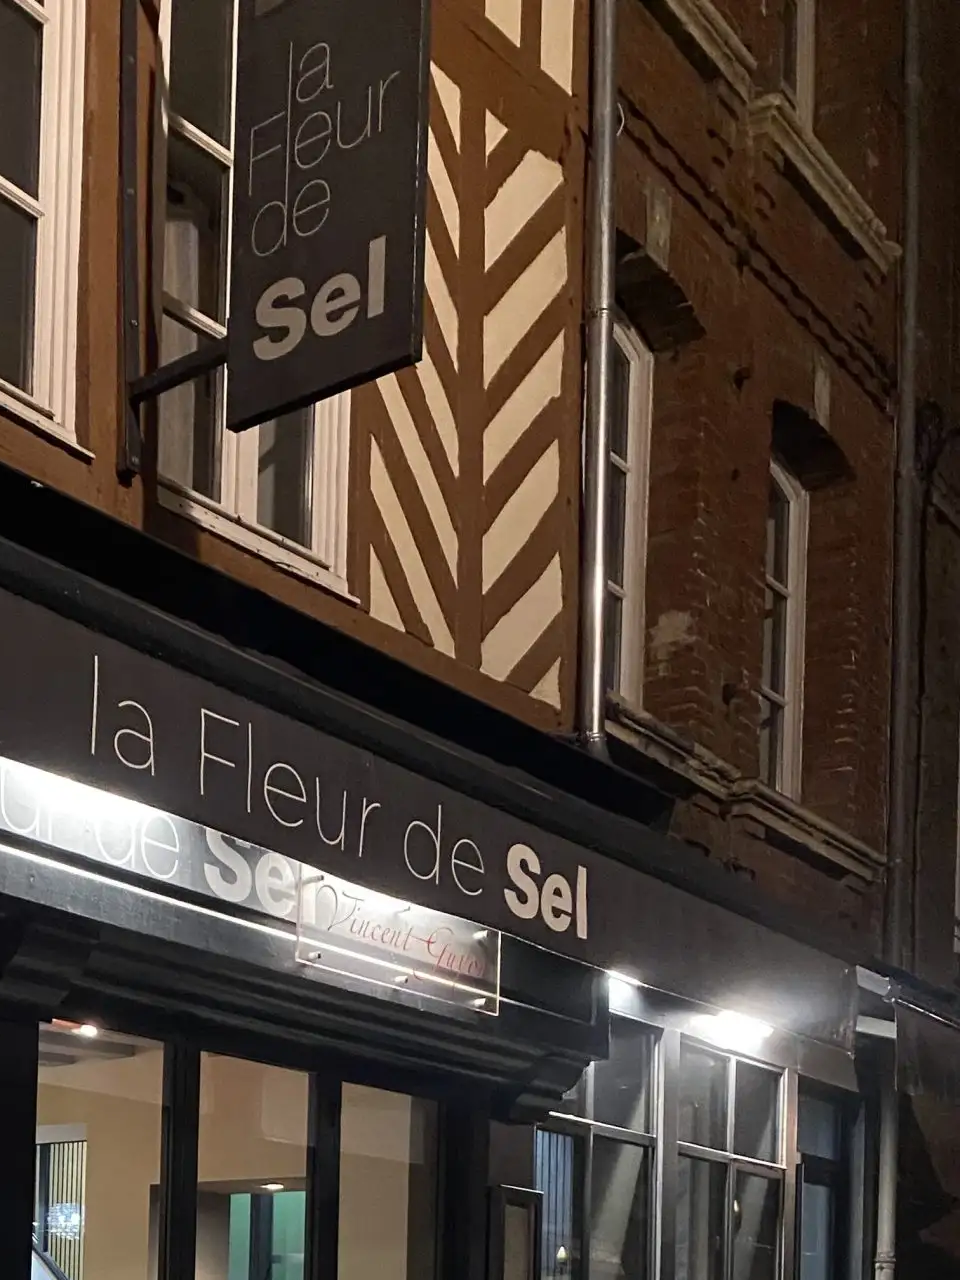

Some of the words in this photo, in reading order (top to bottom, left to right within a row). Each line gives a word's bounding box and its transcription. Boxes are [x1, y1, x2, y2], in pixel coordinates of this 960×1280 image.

[287, 41, 334, 106] la
[248, 70, 401, 197] Fleur
[251, 175, 331, 257] de
[252, 234, 387, 361] Sel
[91, 655, 155, 776] la
[199, 707, 382, 858] Fleur
[403, 804, 485, 896] de
[503, 842, 589, 940] Sel
[316, 884, 417, 952] Vincent
